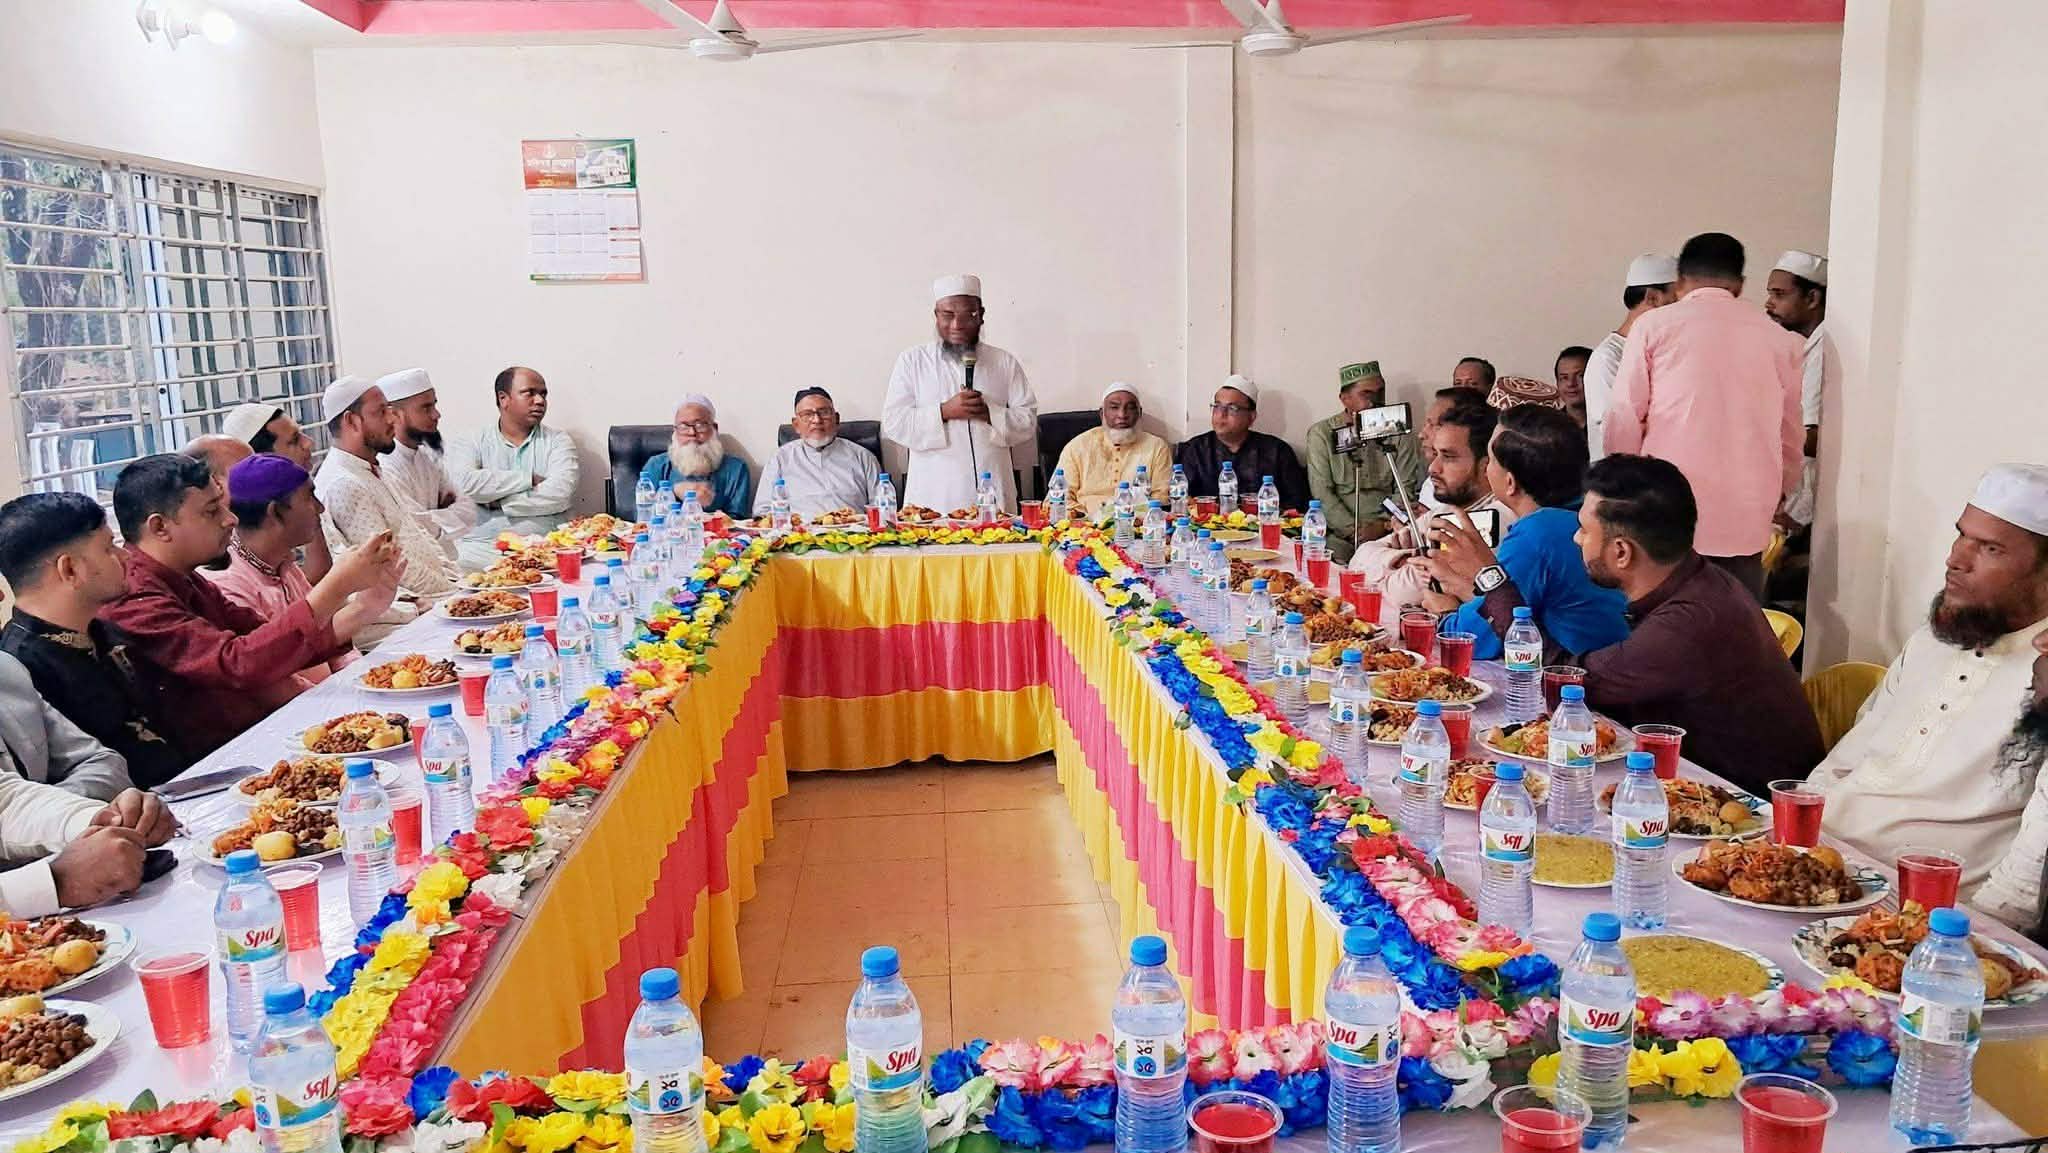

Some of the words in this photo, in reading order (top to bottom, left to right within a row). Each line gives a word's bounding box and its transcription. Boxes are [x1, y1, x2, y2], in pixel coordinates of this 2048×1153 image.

[1514, 652, 1531, 662] Spa
[1639, 820, 1665, 836] Spa
[244, 927, 274, 948] Spa
[1584, 1008, 1620, 1030] Spa
[1328, 1020, 1357, 1045] Spa
[886, 1046, 917, 1073] Spa
